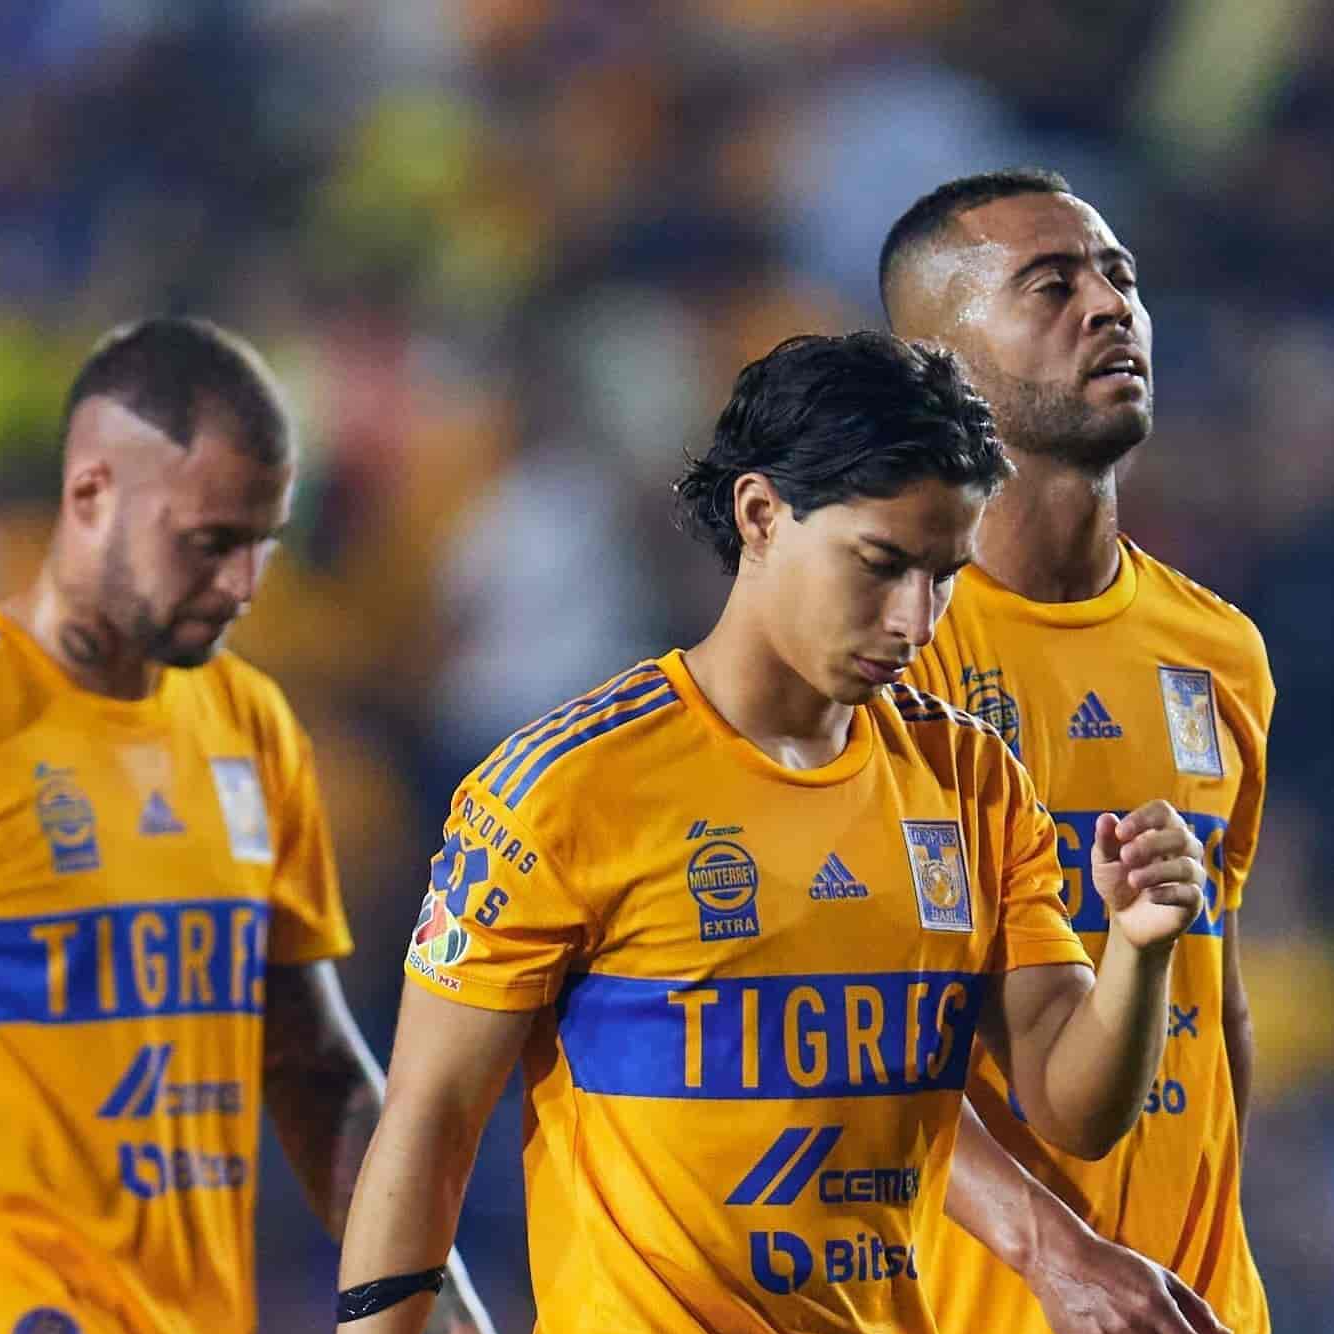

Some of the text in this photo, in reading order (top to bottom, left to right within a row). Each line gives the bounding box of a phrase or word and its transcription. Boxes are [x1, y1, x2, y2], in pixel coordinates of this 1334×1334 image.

[462, 796, 538, 875] AZONAS
[689, 864, 755, 889] MONTERREY
[704, 917, 756, 937] EXTRA
[438, 974, 461, 992] MX
